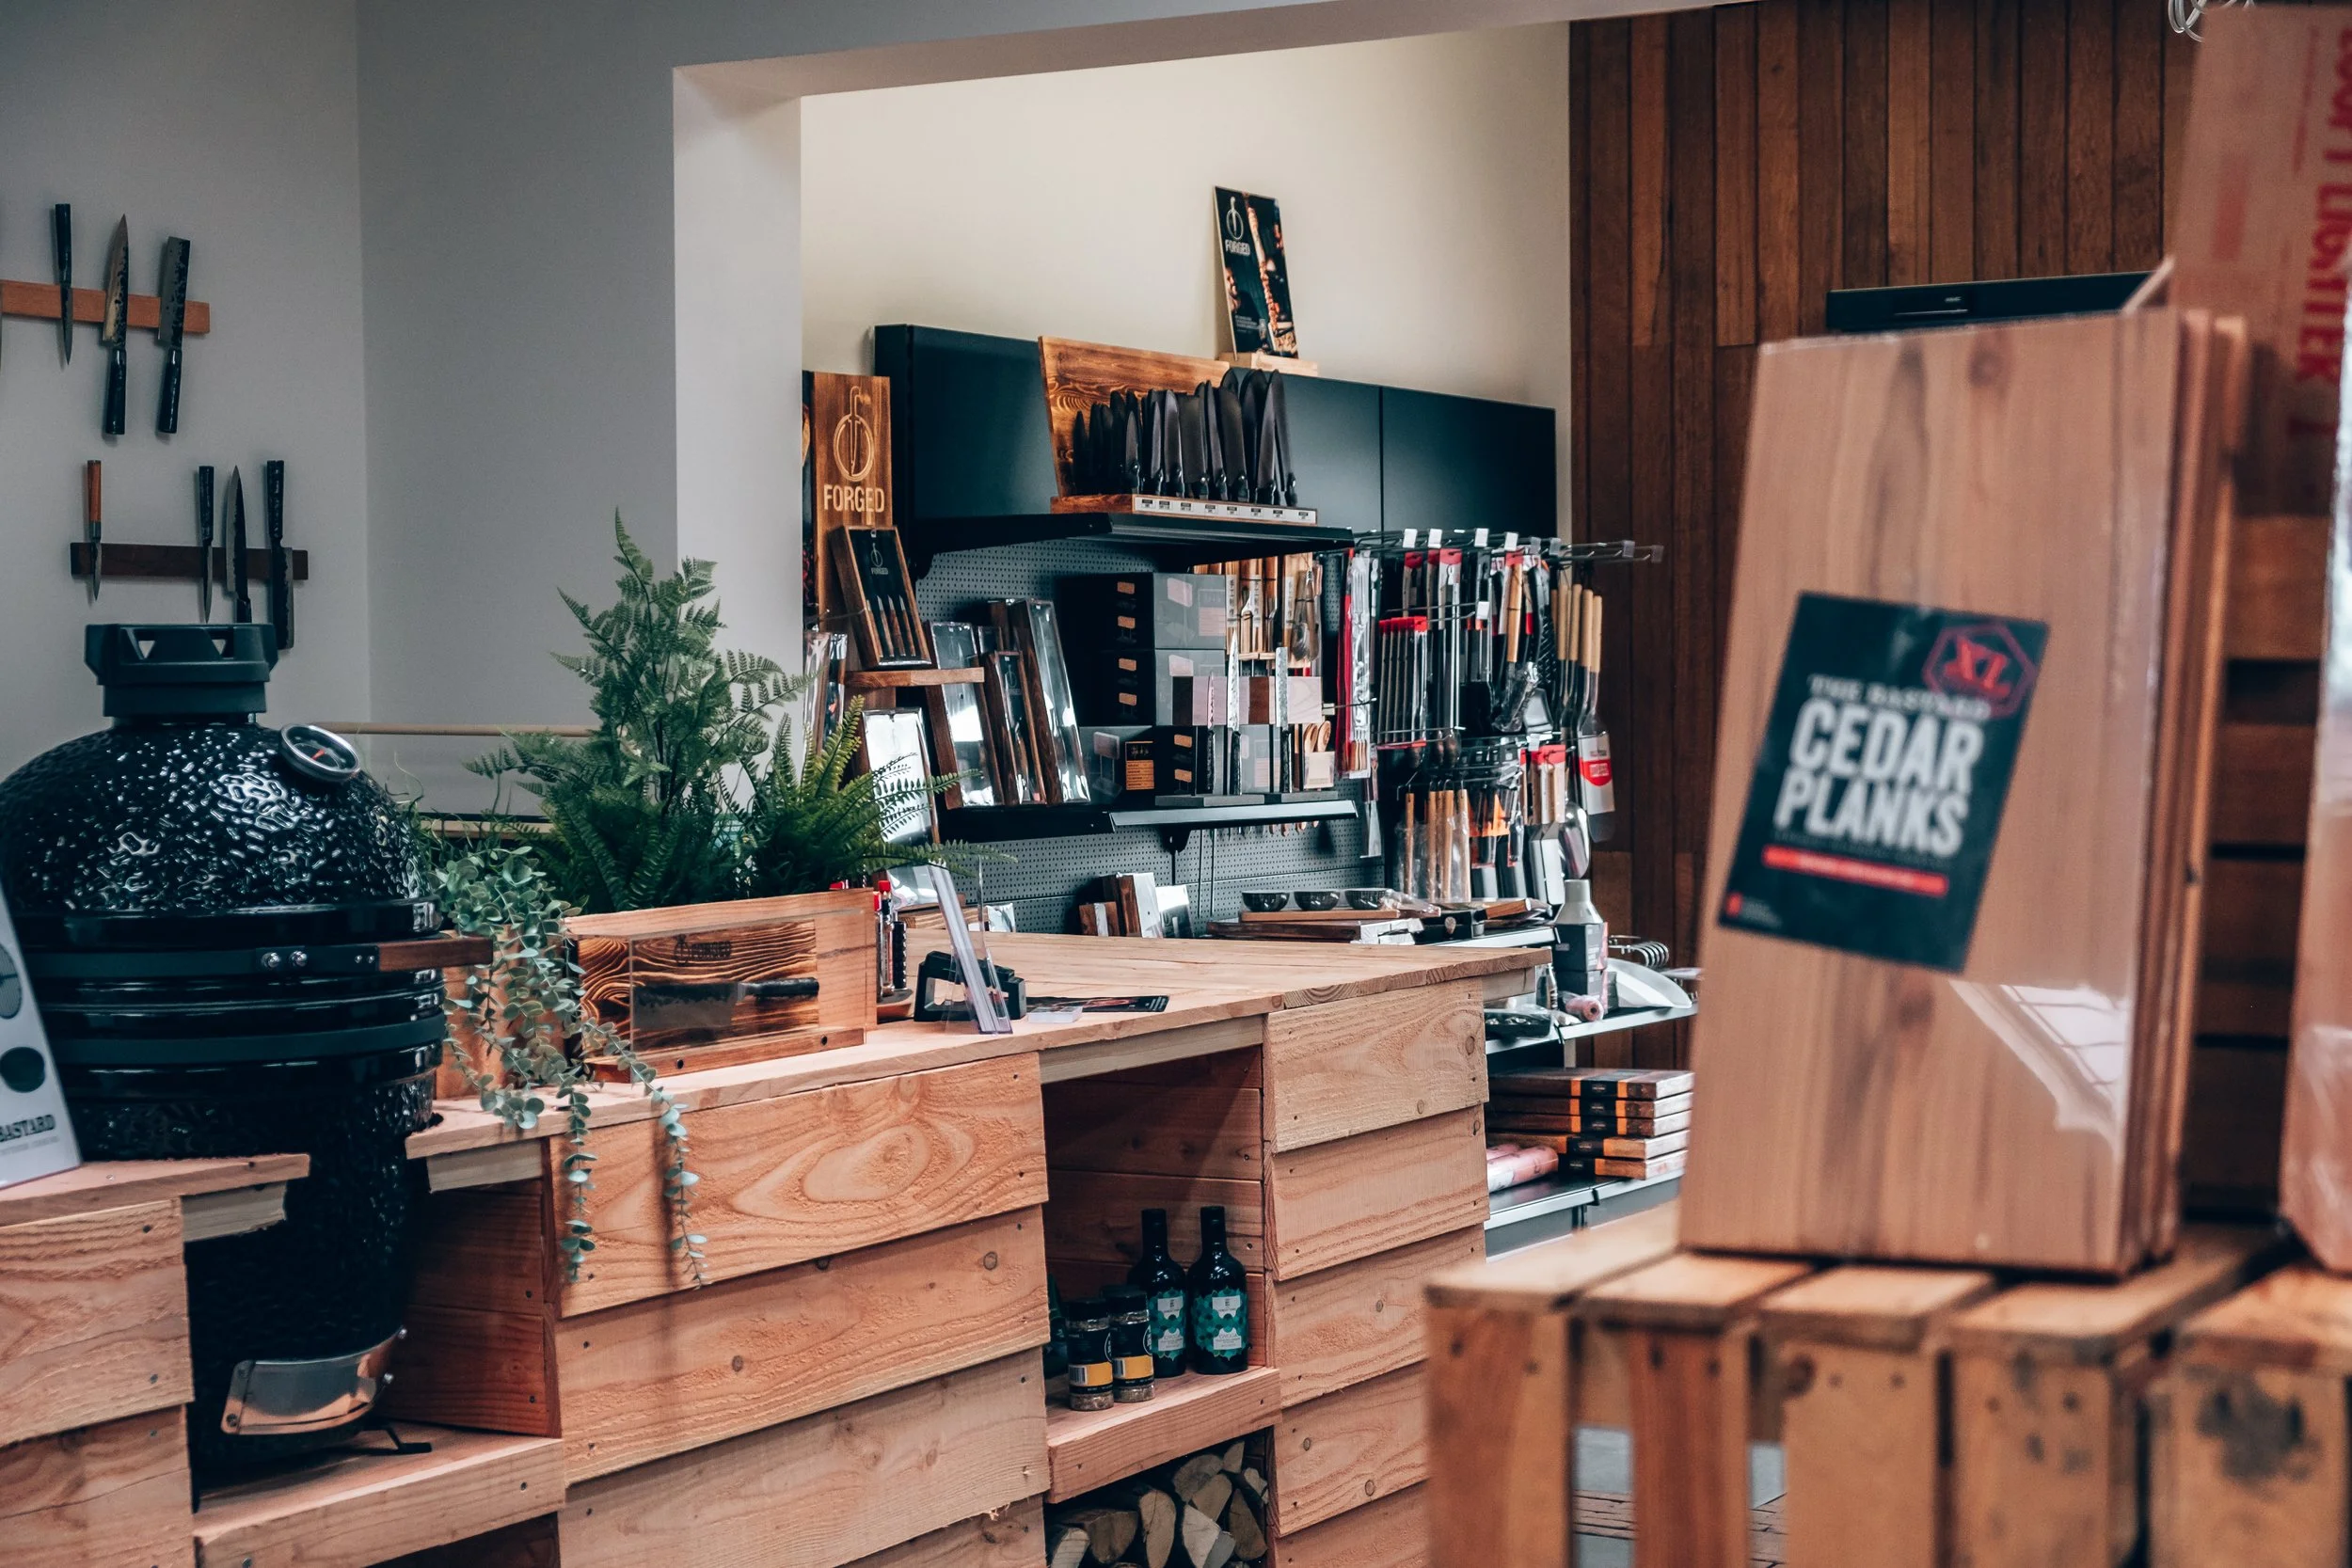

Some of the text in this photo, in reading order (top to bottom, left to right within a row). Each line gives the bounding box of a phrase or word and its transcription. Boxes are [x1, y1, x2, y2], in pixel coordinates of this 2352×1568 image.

[1225, 239, 1250, 256] FORGED
[823, 483, 885, 513] FORGED
[1944, 636, 2011, 696] XL
[1791, 698, 1985, 794] CEDAR
[1772, 766, 1970, 858] PLANKS
